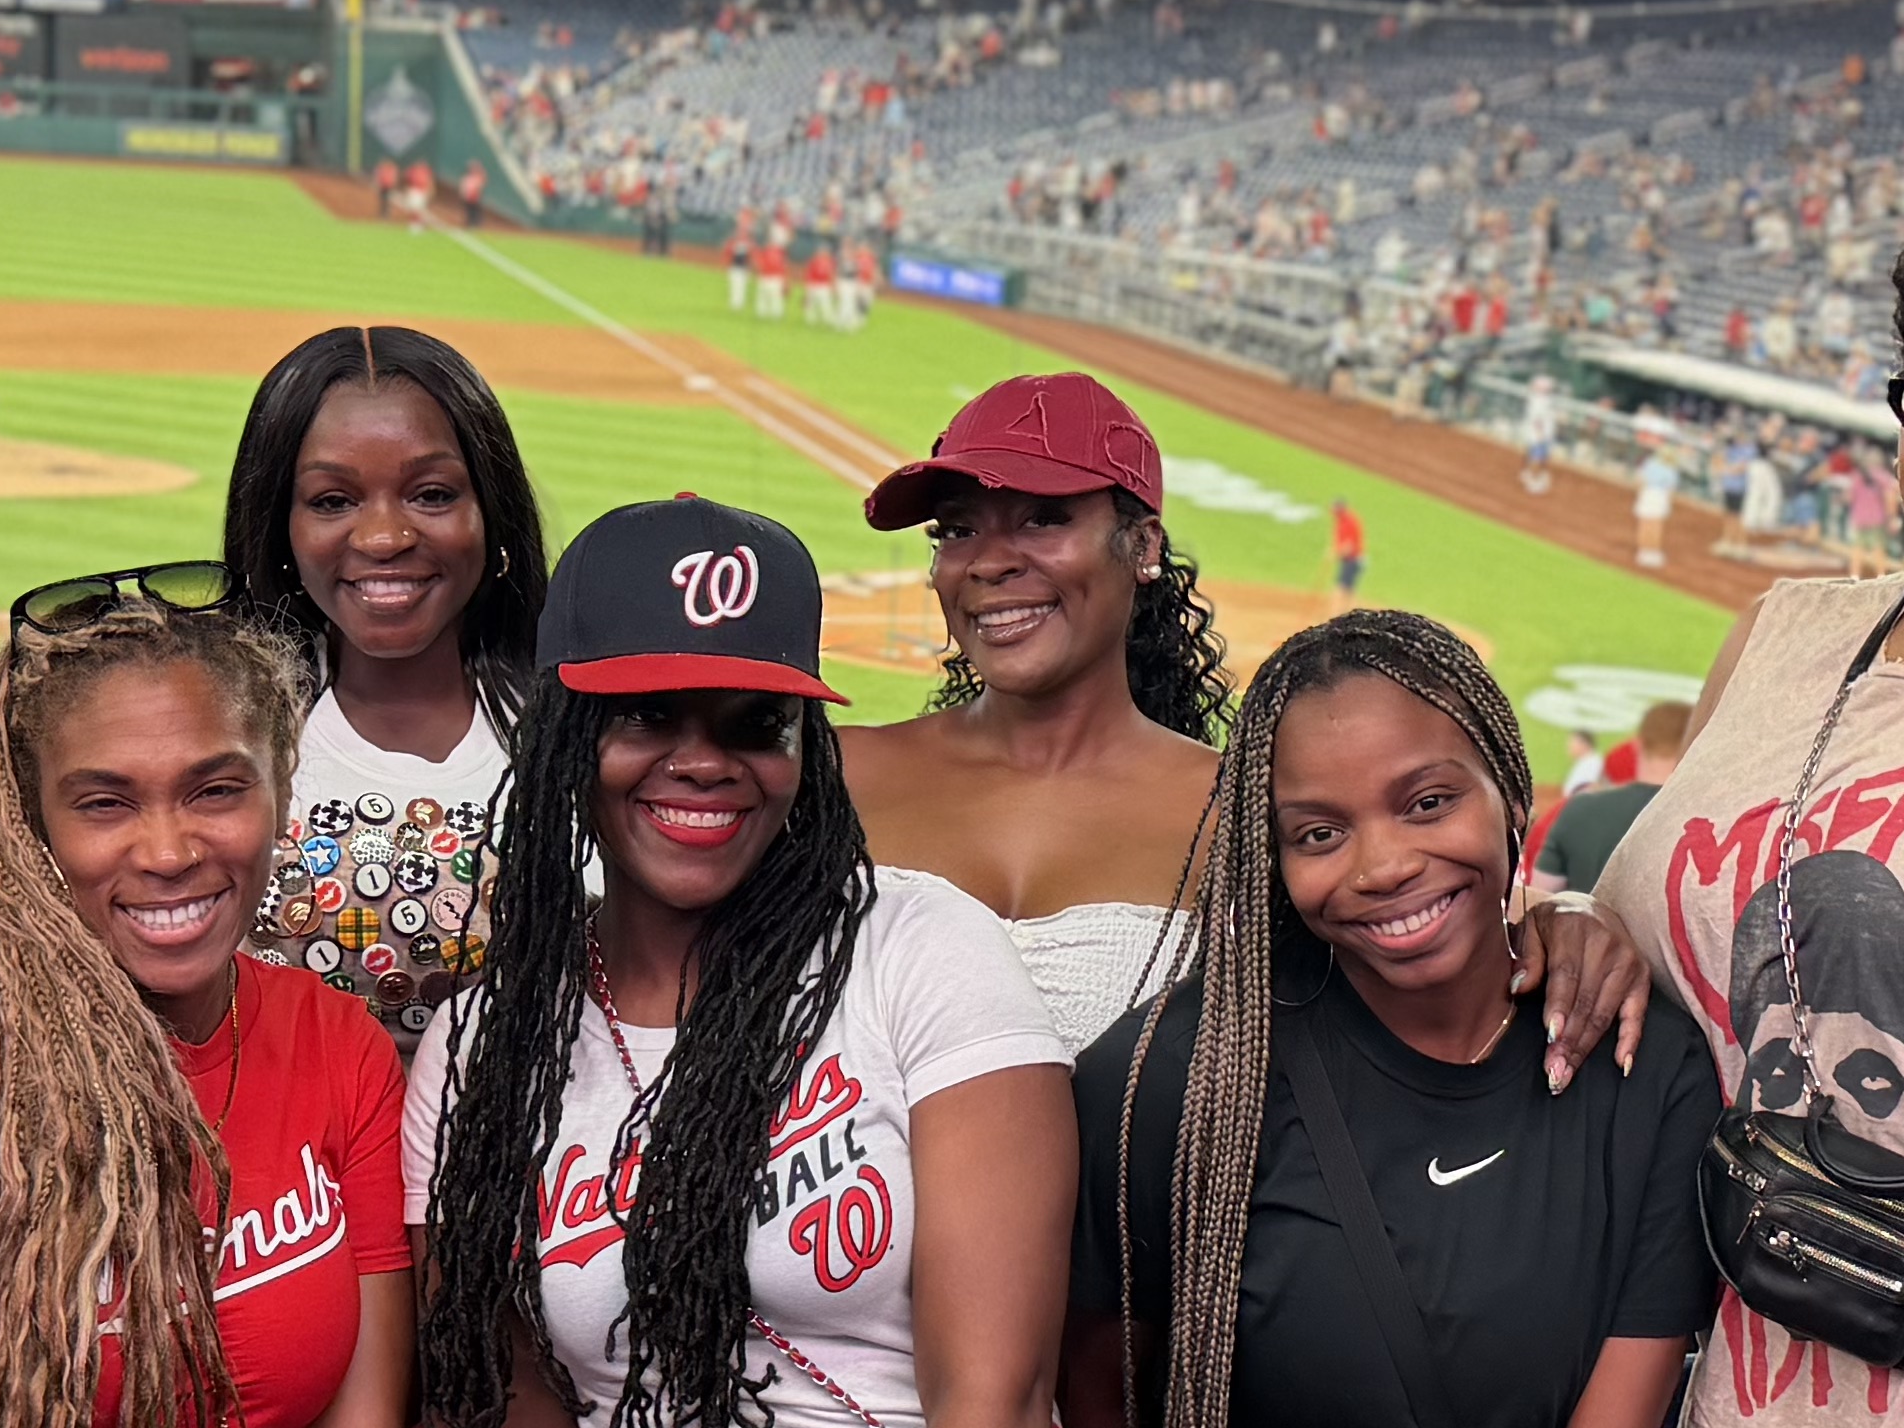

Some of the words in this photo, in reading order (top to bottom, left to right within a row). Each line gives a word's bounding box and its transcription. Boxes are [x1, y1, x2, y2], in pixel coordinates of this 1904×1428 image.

[670, 544, 760, 629] W
[367, 797, 384, 814] 5
[370, 868, 380, 891] 1
[401, 904, 417, 926] 5
[316, 945, 332, 966] 1
[412, 1009, 426, 1025] 5
[788, 1163, 894, 1294] W
